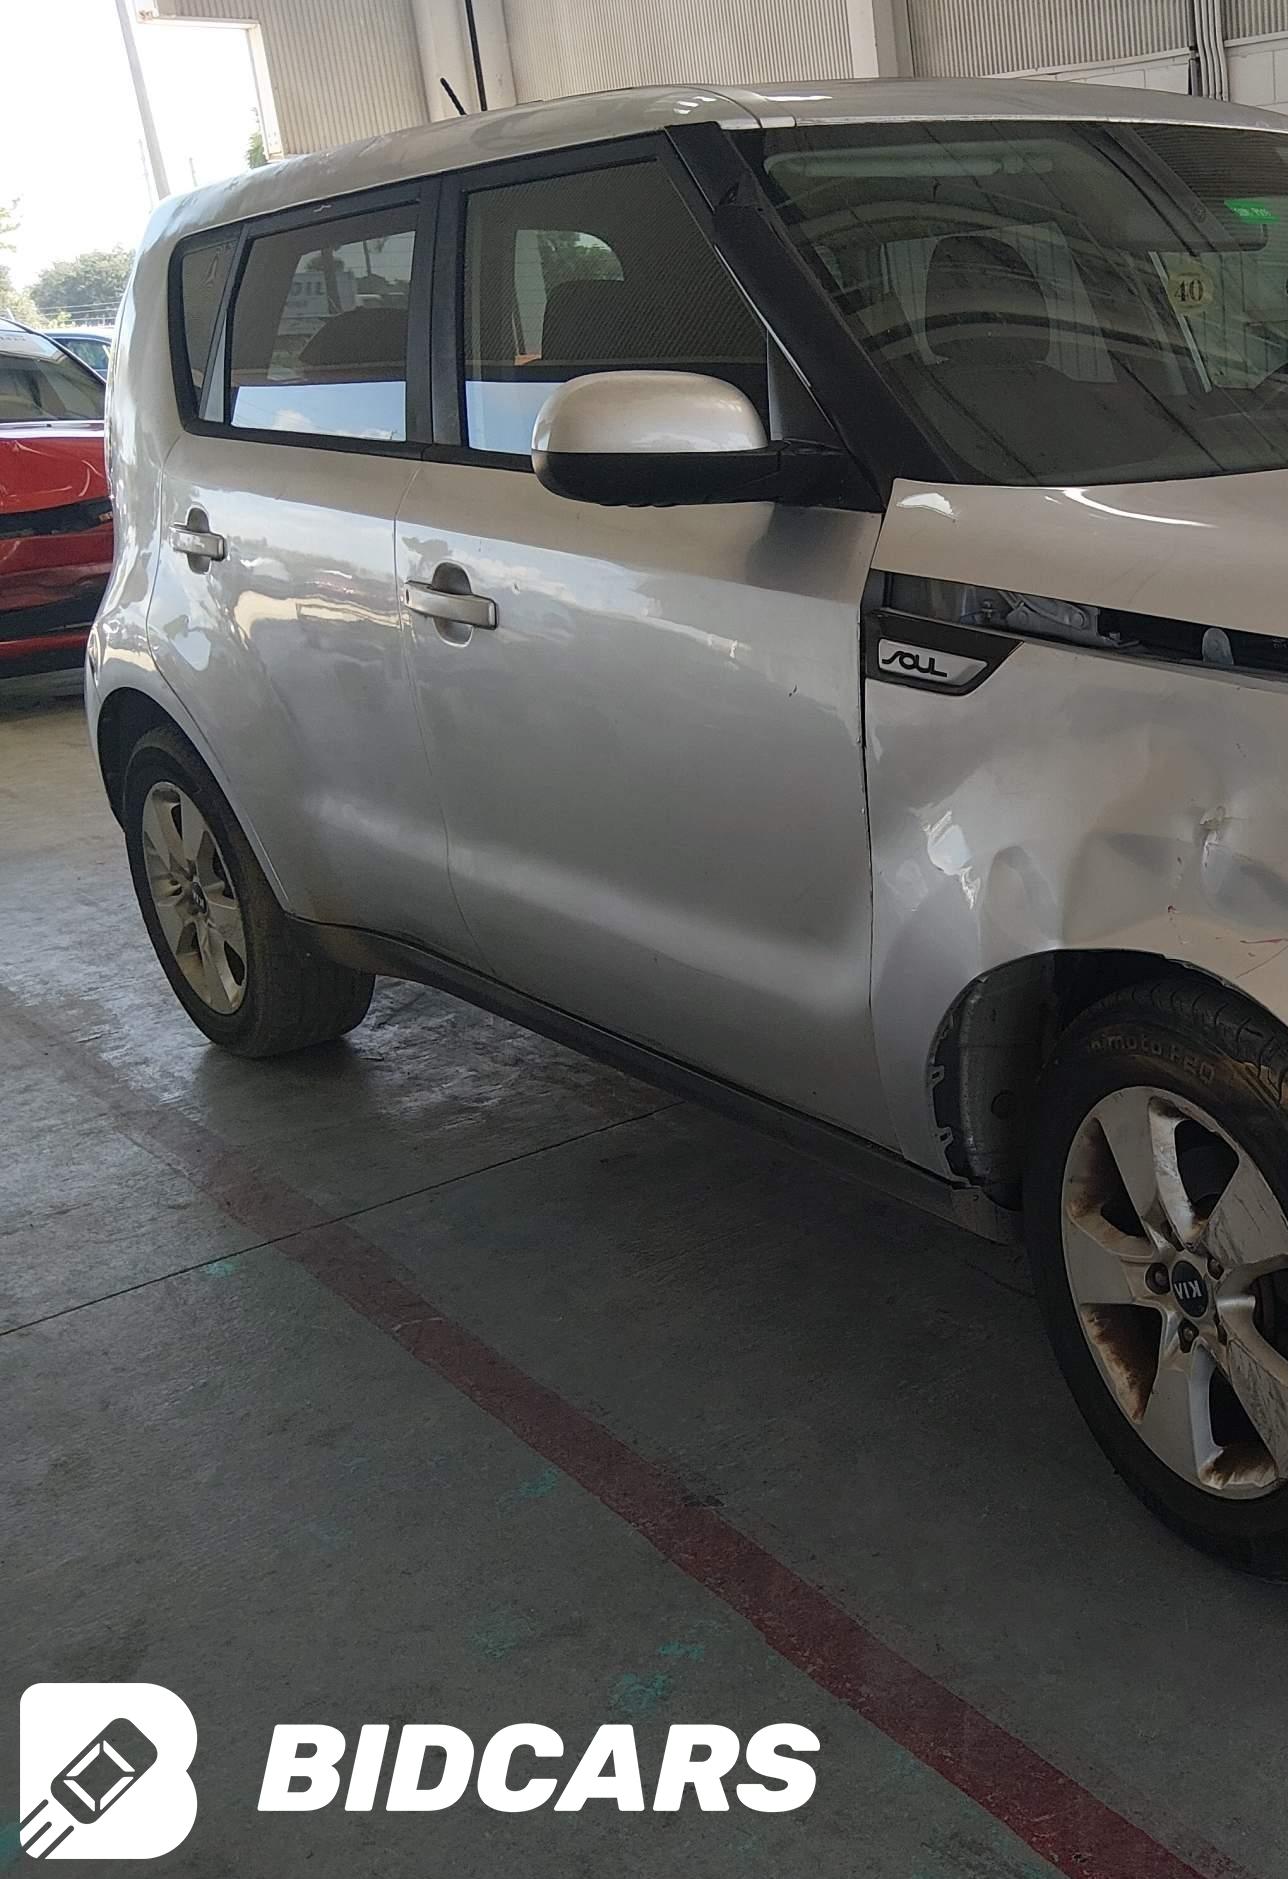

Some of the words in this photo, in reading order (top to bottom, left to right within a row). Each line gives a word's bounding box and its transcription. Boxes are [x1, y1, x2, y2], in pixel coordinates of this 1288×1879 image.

[1174, 279, 1204, 302] 40
[881, 650, 948, 678] SOUL
[1173, 1279, 1203, 1300] KIA
